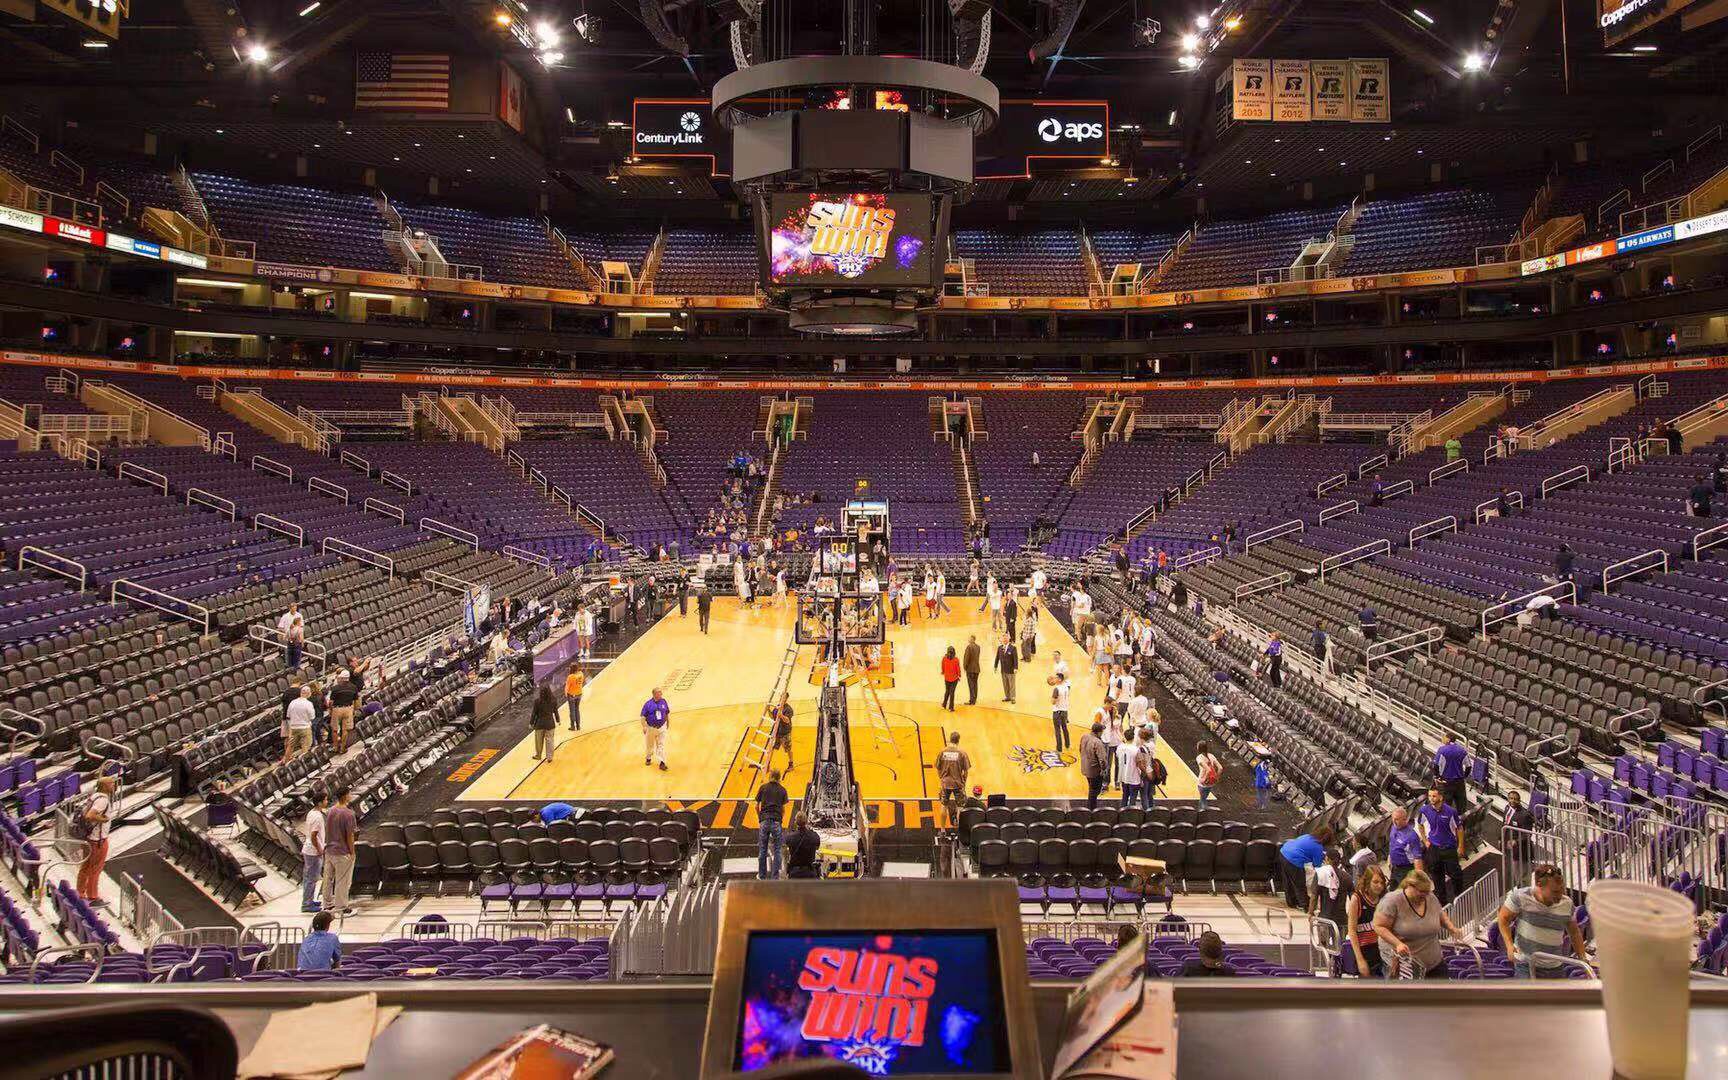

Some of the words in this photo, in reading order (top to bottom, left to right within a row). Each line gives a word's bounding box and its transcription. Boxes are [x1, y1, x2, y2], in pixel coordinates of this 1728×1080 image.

[1242, 108, 1263, 117] 2013
[636, 132, 703, 145] CenturyLink
[1064, 122, 1103, 142] aps
[807, 202, 896, 232] SUNS
[1626, 239, 1638, 248] US
[1639, 230, 1672, 246] AIRWAYS
[257, 268, 317, 280] CHAMPIONS
[799, 947, 939, 999] SUNS
[800, 993, 929, 1047] WIN!
